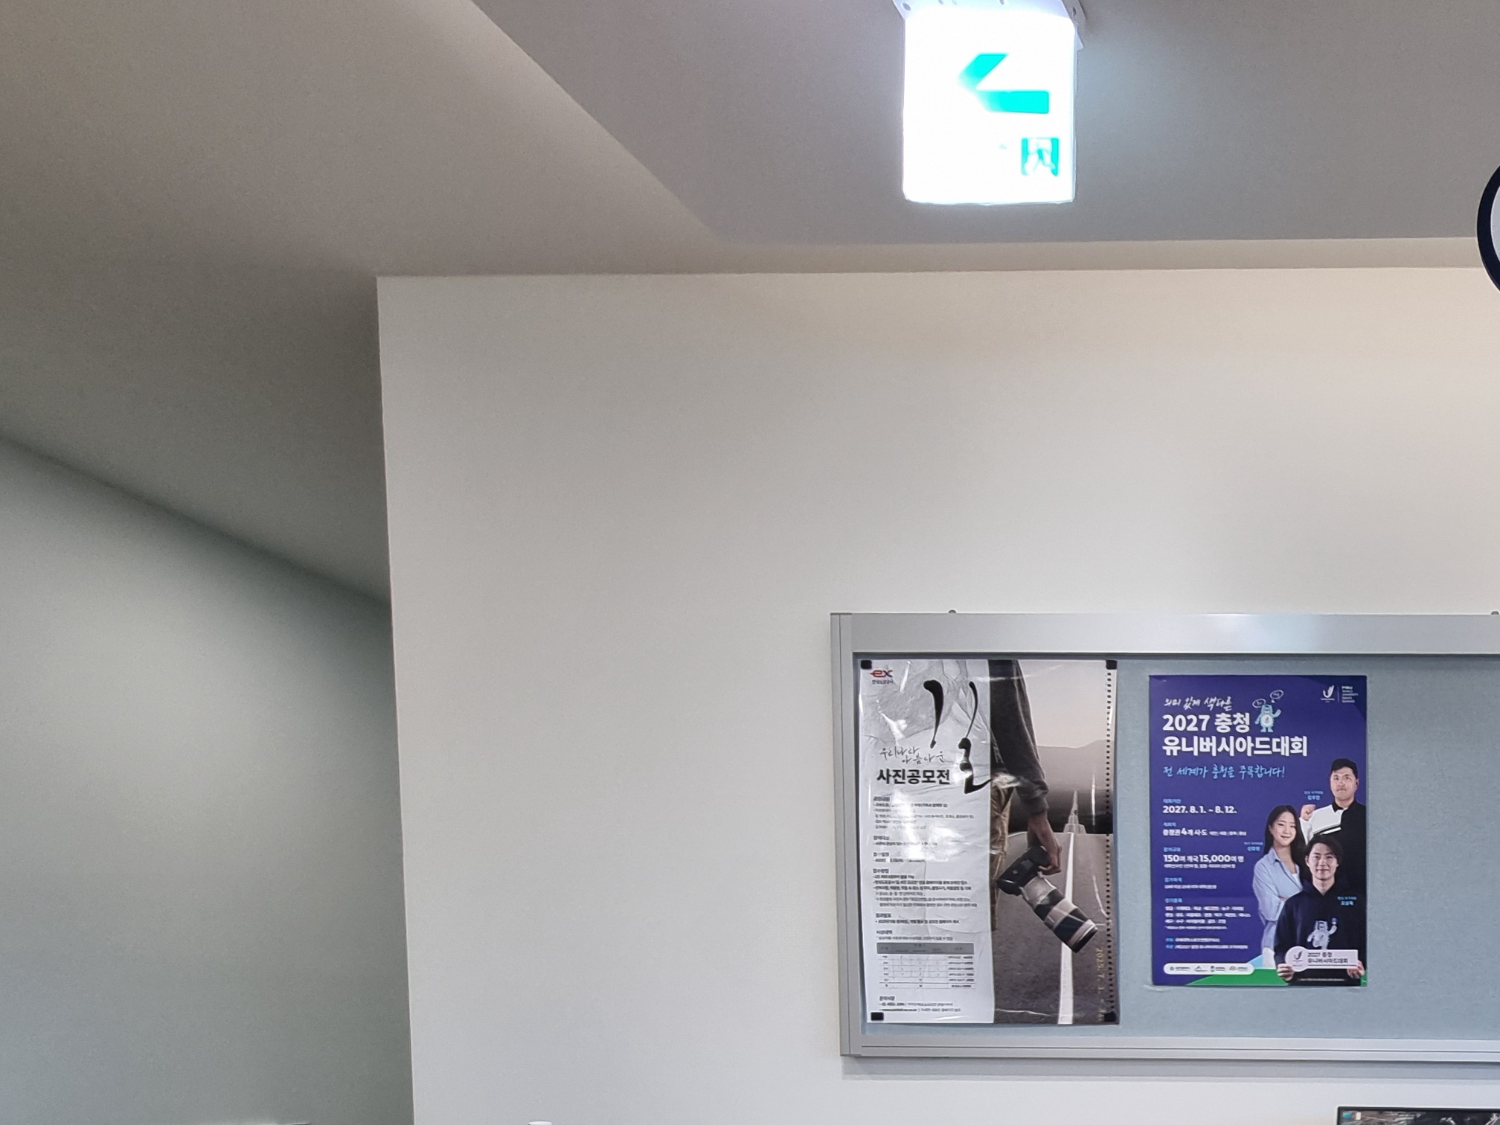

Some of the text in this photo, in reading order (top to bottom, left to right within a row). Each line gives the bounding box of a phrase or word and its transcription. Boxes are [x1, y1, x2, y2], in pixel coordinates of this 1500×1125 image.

[1162, 712, 1250, 733] 2027 충청
[1162, 736, 1308, 757] 유니버시아드대회
[876, 768, 951, 785] 사진공모전
[1163, 764, 1286, 780] 전 세계가 충청을 주목합니다!
[1162, 805, 1188, 814] 2027.
[1189, 805, 1199, 814] 8.
[1199, 805, 1207, 814] 1.
[1215, 805, 1224, 814] 8.
[1225, 805, 1238, 814] 12.
